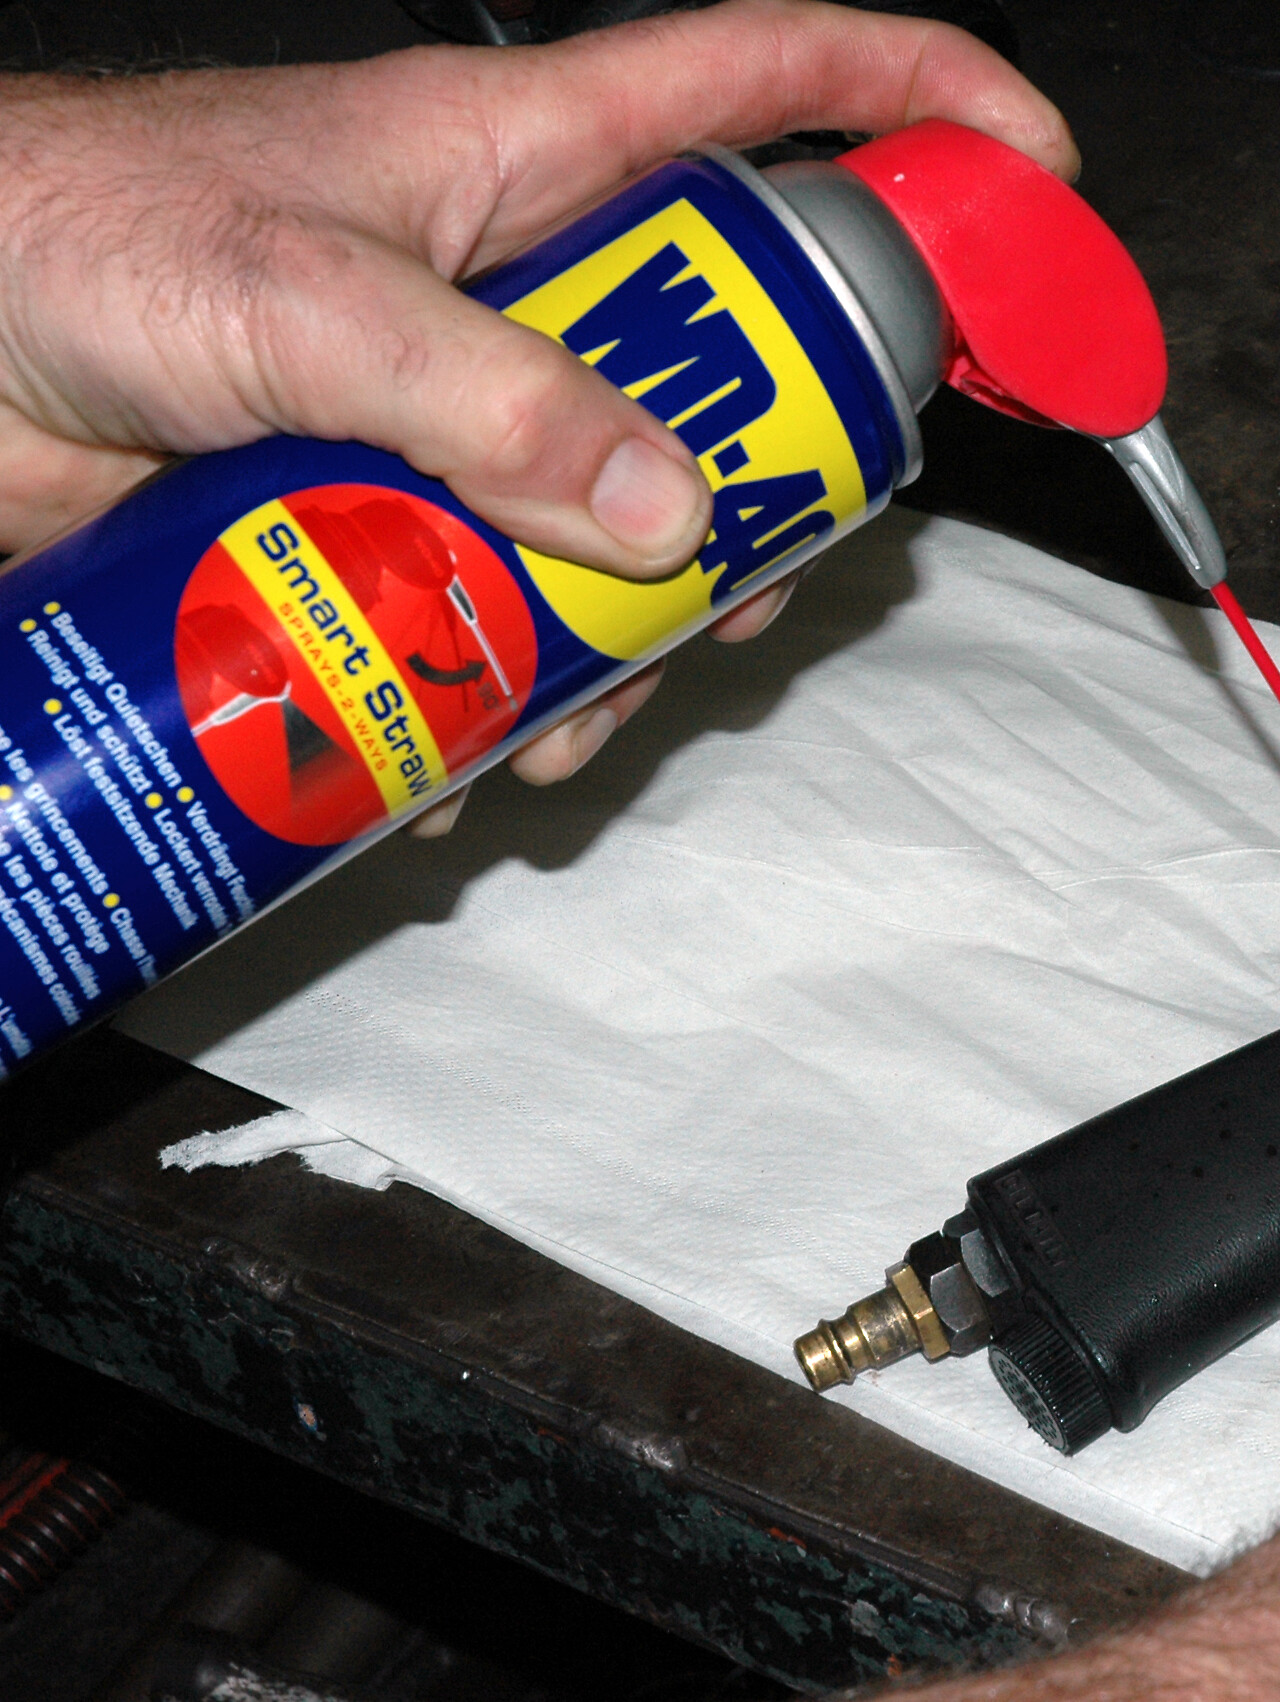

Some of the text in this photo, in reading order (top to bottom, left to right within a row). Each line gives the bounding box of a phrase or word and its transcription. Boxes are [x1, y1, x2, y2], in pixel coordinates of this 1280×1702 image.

[559, 241, 837, 611] WD-40
[27, 629, 80, 690] Reinigt
[70, 687, 108, 725] und
[96, 724, 153, 795] schützt
[153, 808, 203, 874] Lockert
[51, 611, 114, 686] Beseitigt
[105, 683, 182, 788] Quietschen
[186, 801, 240, 880] Verdrängt
[256, 522, 431, 798] Smart Straw
[279, 602, 388, 771] SPRAYS-2-WAYS
[4, 749, 34, 782] les
[23, 782, 109, 895] grincements
[110, 907, 147, 960] Chasse
[4, 854, 101, 1001] les pièces rouillées
[5, 802, 111, 954] Nettoie et protège
[53, 713, 199, 931] Löst festsitzende Mechanik
